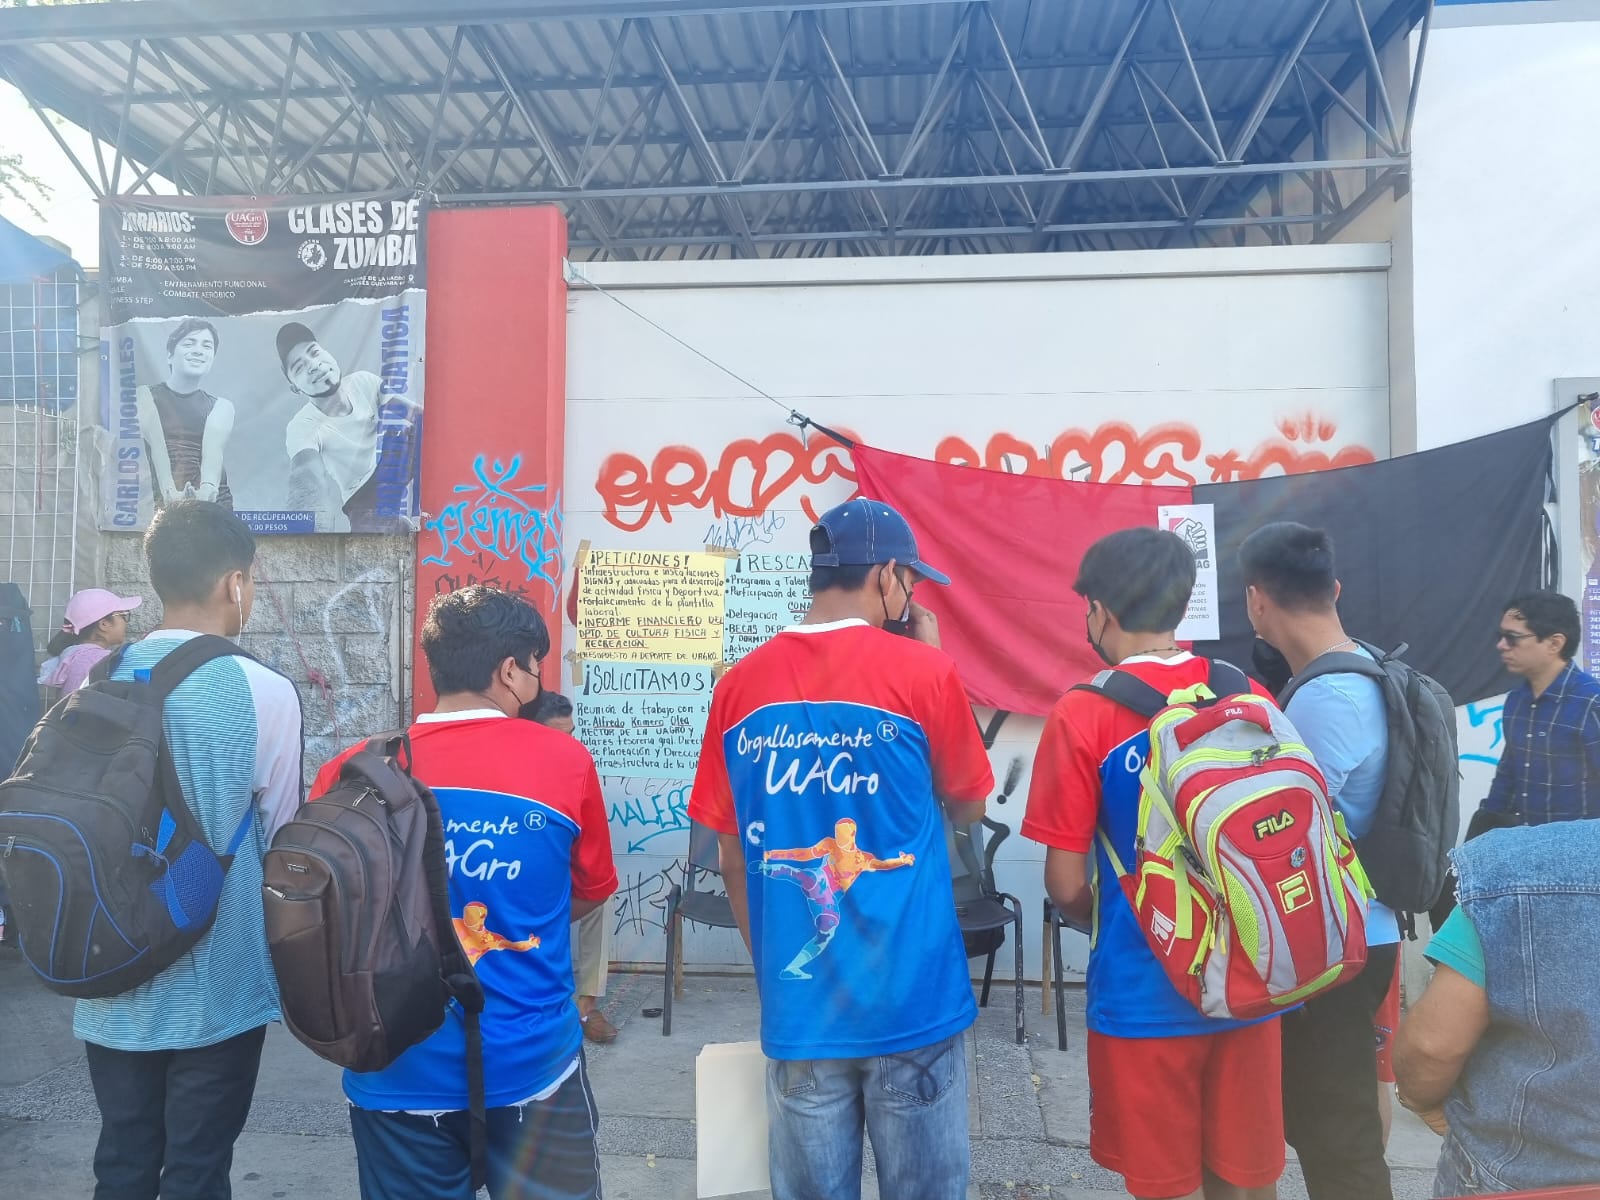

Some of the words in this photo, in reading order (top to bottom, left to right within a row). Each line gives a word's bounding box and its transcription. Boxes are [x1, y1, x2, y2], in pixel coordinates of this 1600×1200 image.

[288, 201, 383, 234] CLASES
[390, 199, 419, 231] DE
[334, 234, 417, 270] ZUMBA
[163, 289, 200, 299] COMBATE
[380, 304, 410, 395] GATICA
[119, 337, 141, 440] MORALES
[113, 446, 140, 527] CARLOS
[241, 513, 252, 521] DE
[787, 587, 797, 598] de
[585, 617, 631, 627] INFORME
[637, 616, 702, 626] FINANCIERO
[729, 624, 758, 633] BECAS
[607, 629, 619, 638] DE
[626, 628, 668, 637] CULTURA
[622, 700, 633, 714] de
[642, 699, 674, 719] trabajo
[1225, 707, 1242, 717] FILA
[578, 717, 591, 726] Dr.
[593, 715, 624, 727] Alfredo
[631, 717, 664, 728] Romero
[671, 715, 689, 726] Olea
[581, 728, 615, 736] RECTOR
[737, 724, 873, 762] Orgullosamente
[594, 757, 659, 768] nfraestructura
[663, 758, 673, 768] de
[765, 750, 879, 795] UAGro
[1255, 810, 1295, 840] FILA
[446, 838, 521, 880] AGro
